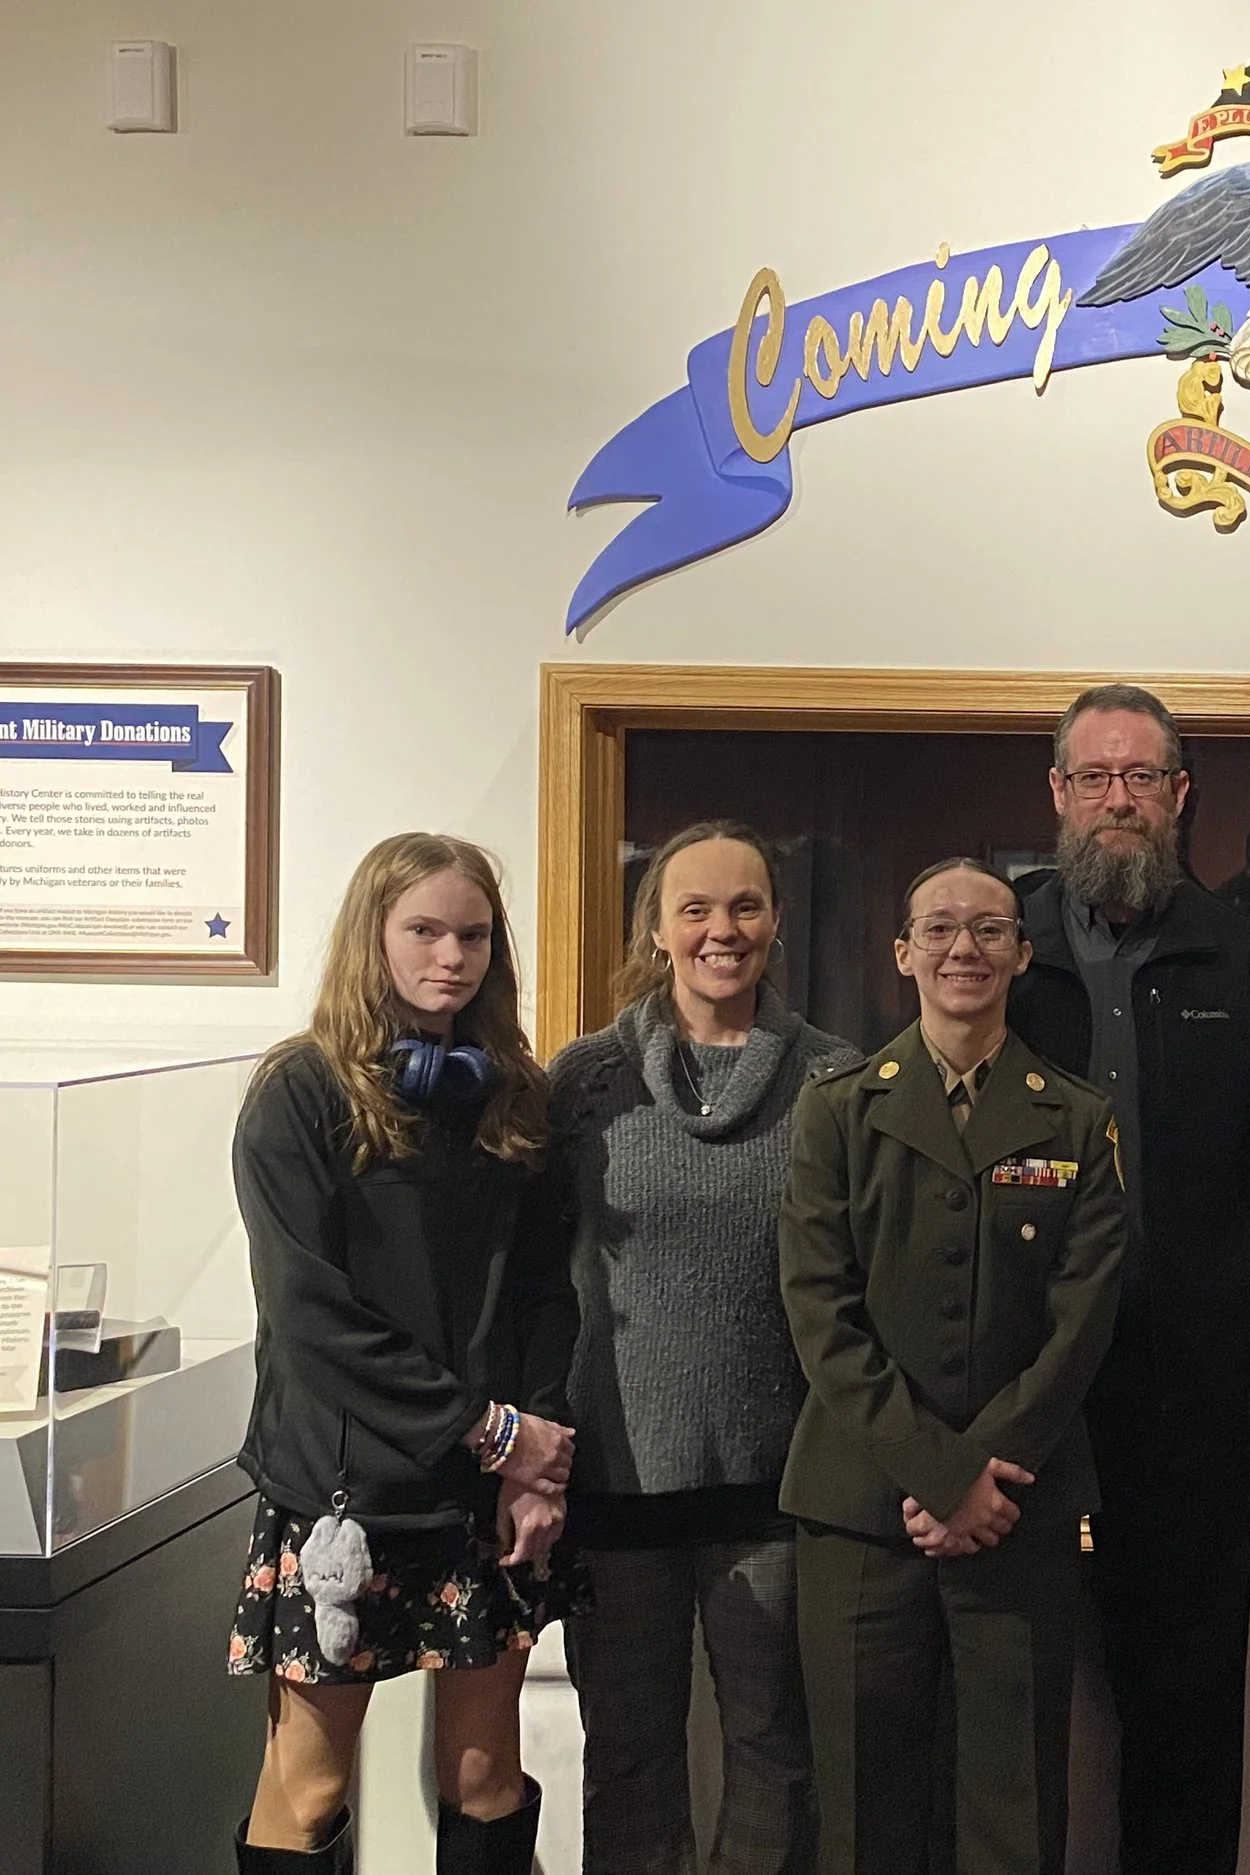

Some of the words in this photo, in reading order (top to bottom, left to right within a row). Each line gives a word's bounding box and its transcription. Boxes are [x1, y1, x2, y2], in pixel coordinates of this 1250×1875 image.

[1197, 115, 1211, 136] E
[727, 241, 1073, 463] Coming
[22, 719, 96, 746] Military
[100, 720, 191, 742] Donations
[31, 789, 63, 798] Center
[74, 790, 124, 799] committed
[126, 791, 136, 799] to
[138, 790, 167, 801] telling
[169, 791, 184, 800] the
[187, 791, 204, 800] real
[29, 802, 60, 811] people
[62, 802, 83, 811] who
[85, 802, 109, 812] lived,
[111, 804, 146, 812] worked
[148, 804, 165, 812] and
[167, 803, 216, 813] influenced
[11, 813, 27, 822] We
[30, 814, 44, 823] tell
[46, 814, 72, 823] those
[75, 815, 105, 823] stories
[108, 815, 133, 826] using
[134, 815, 175, 825] artifacts,
[177, 816, 209, 826] photos
[5, 826, 31, 836] Every
[74, 827, 94, 836] take
[96, 827, 105, 836] in
[106, 828, 139, 837] dozens
[141, 828, 152, 837] of
[153, 828, 192, 838] artifacts
[25, 864, 66, 874] uniforms
[68, 866, 86, 874] and
[88, 866, 113, 875] other
[115, 866, 140, 875] items
[143, 867, 161, 876] that
[163, 868, 186, 876] were
[9, 877, 21, 887] by
[23, 877, 65, 888] Michigan
[67, 879, 107, 887] veterans
[121, 878, 142, 888] their
